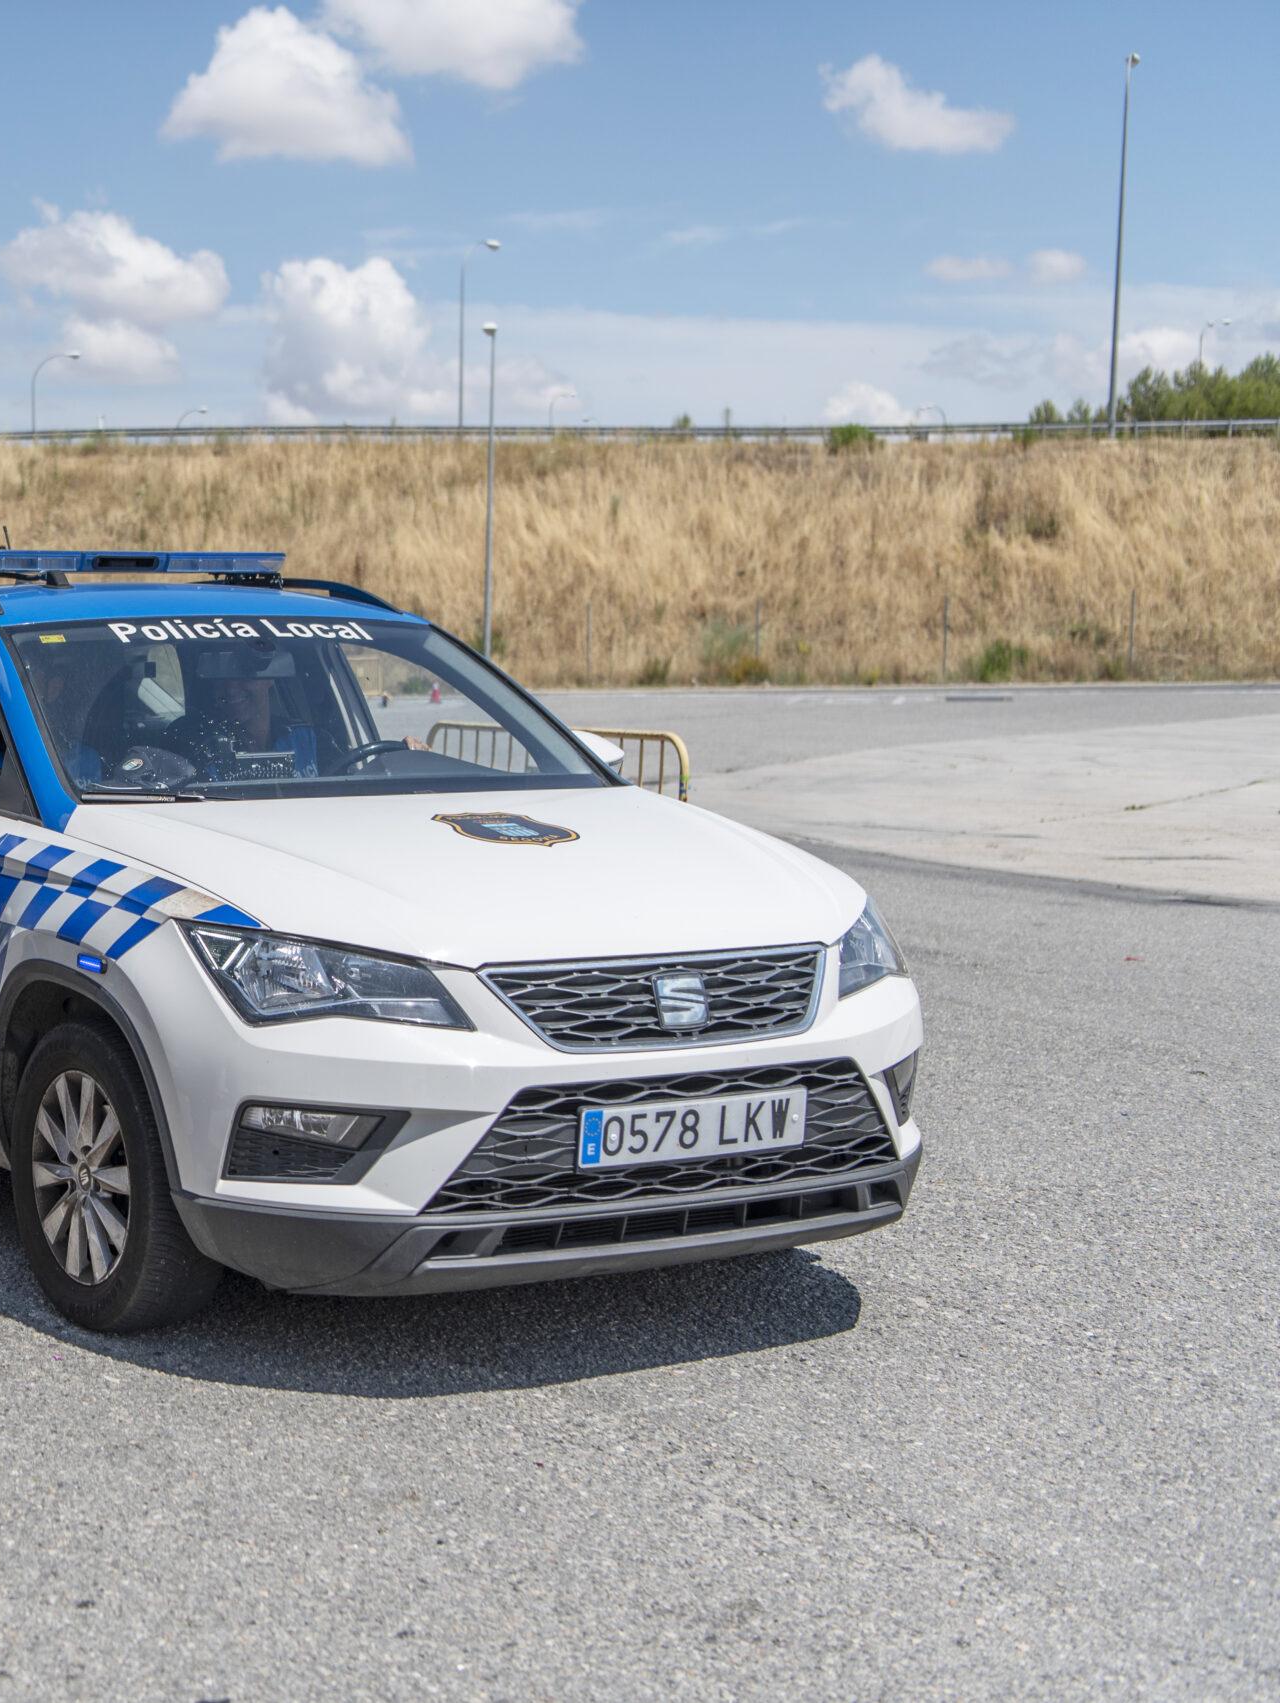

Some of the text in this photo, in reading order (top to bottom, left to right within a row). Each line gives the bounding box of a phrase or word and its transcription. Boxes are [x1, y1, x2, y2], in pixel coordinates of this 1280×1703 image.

[107, 618, 374, 643] Policía Local
[587, 1097, 790, 1157] E 0578 LKW
